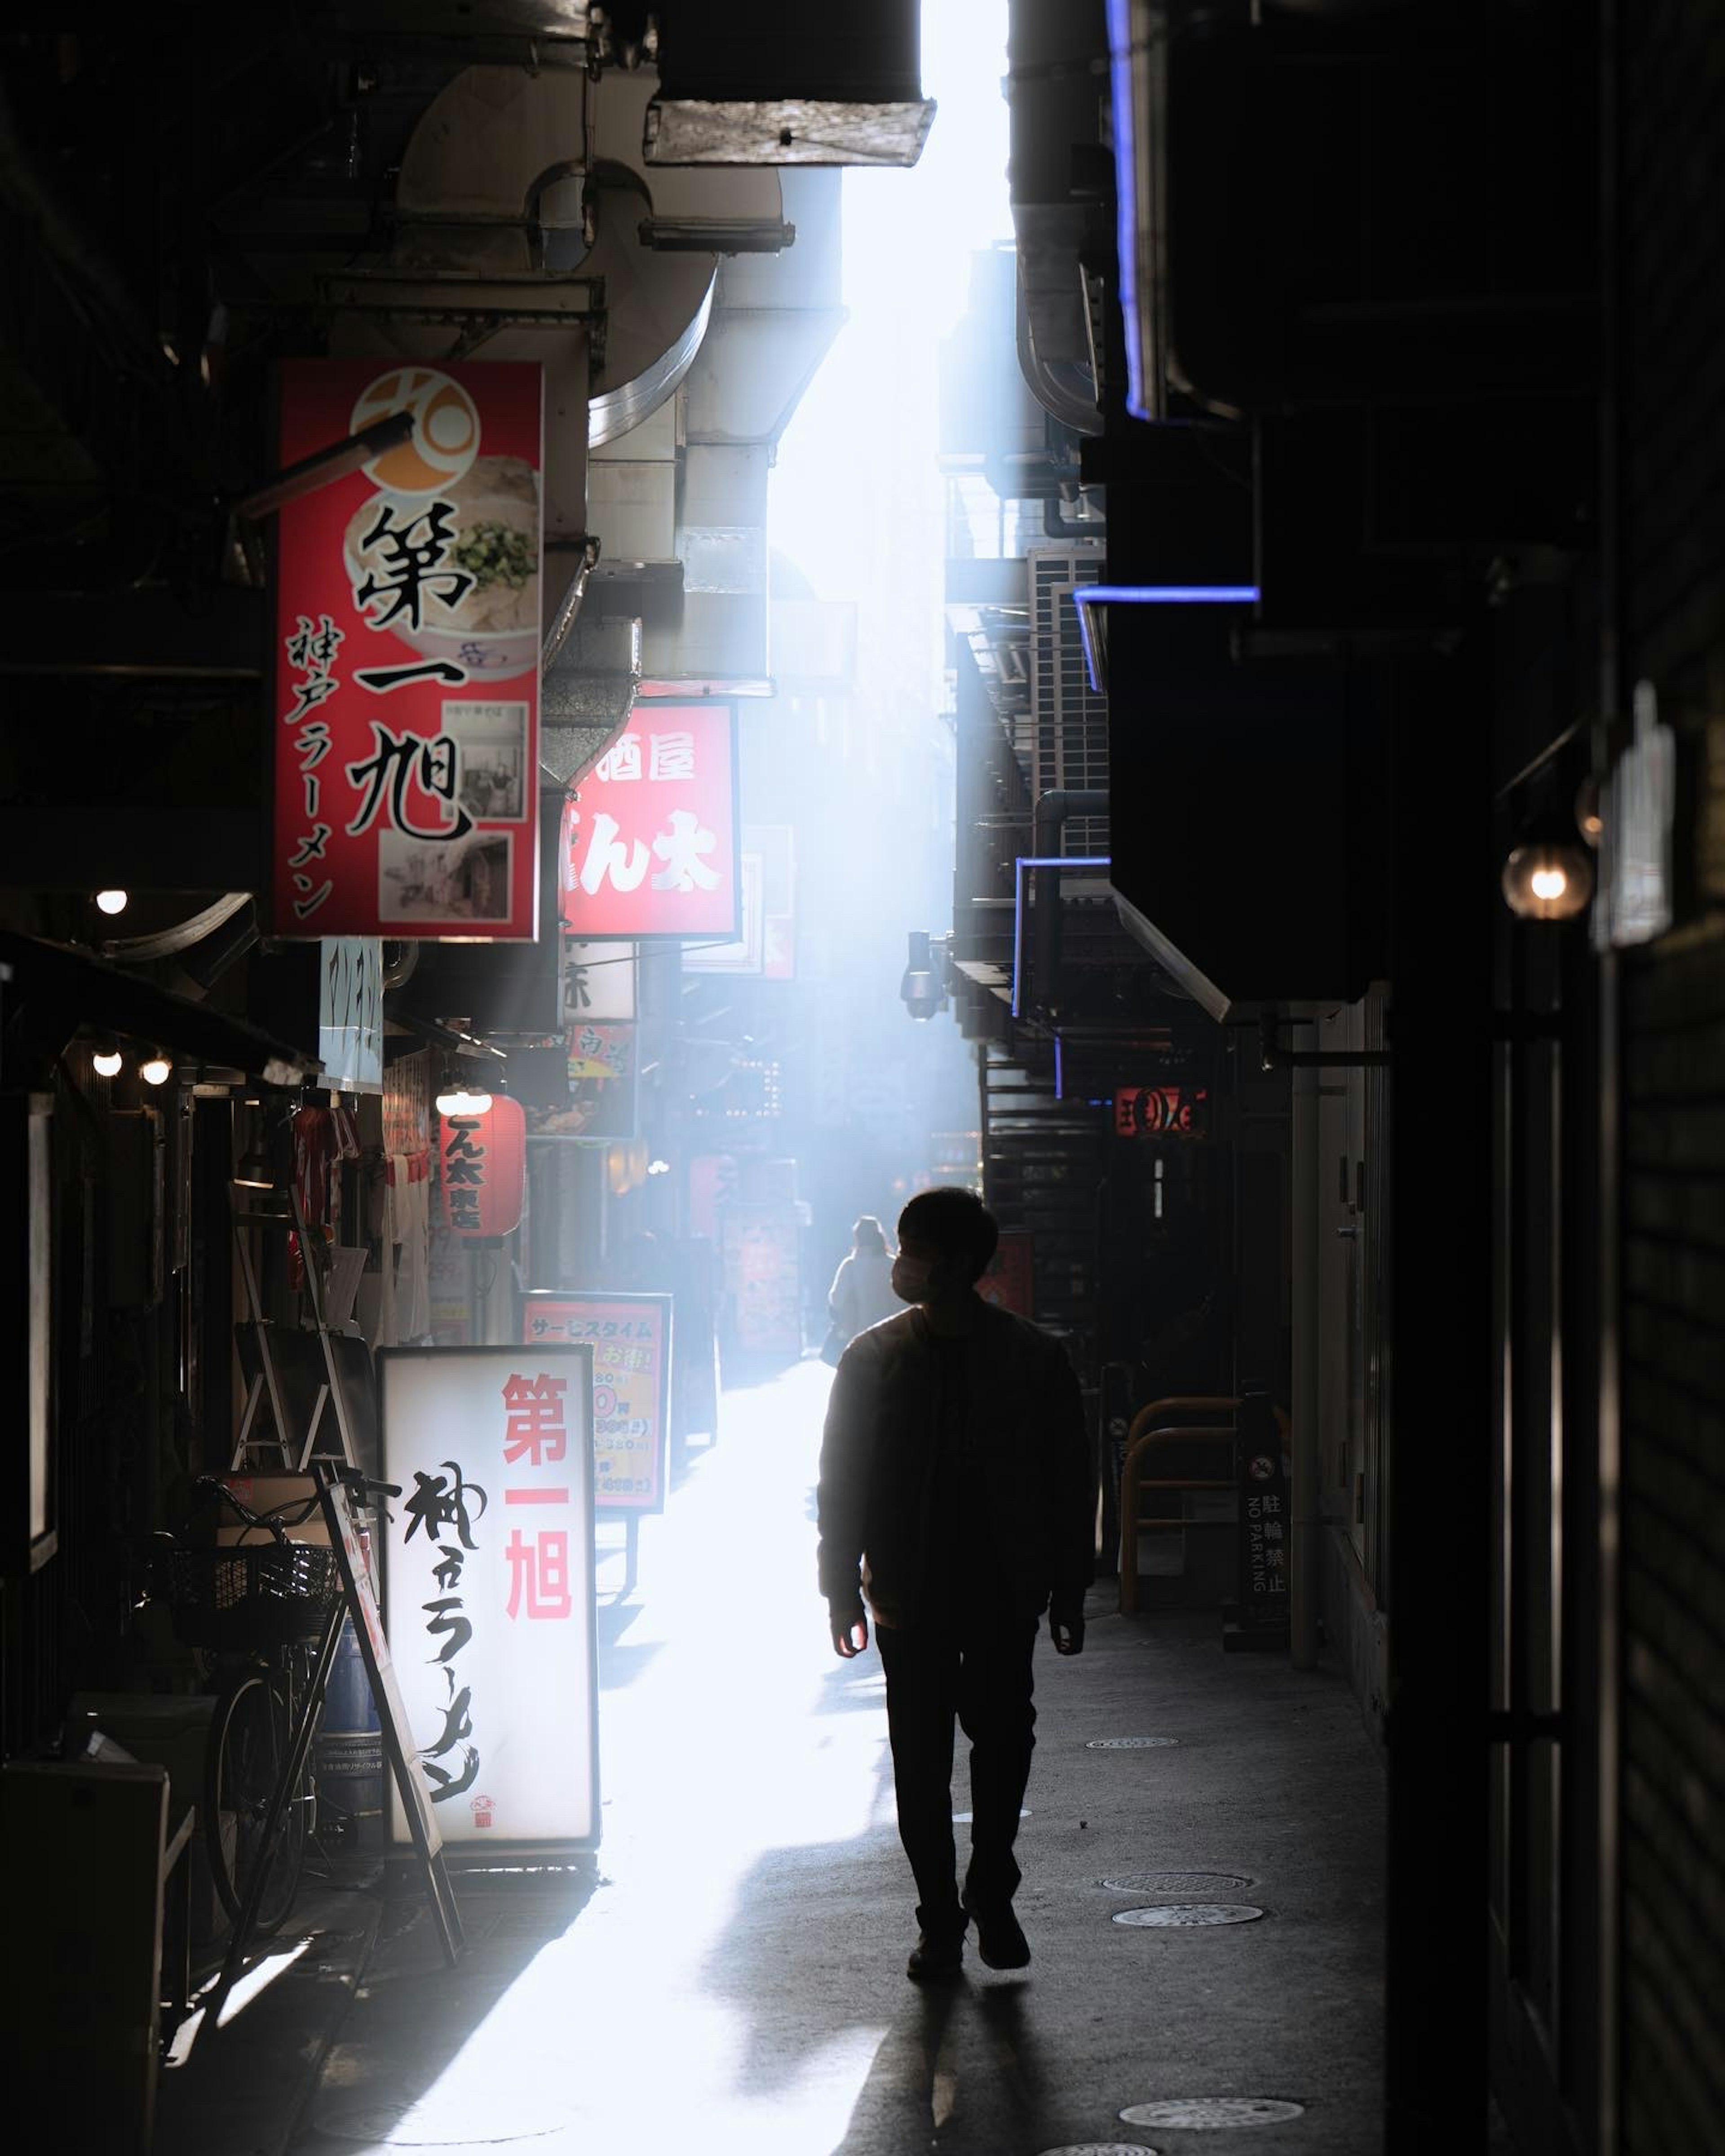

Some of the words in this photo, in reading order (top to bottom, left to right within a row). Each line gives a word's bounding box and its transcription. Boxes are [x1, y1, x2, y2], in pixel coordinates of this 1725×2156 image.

[349, 503, 477, 841] 第一旭
[286, 617, 345, 919] 神戸ラーメン
[565, 808, 723, 895] ん太
[502, 1372, 571, 1621] 第一旭
[1247, 1496, 1262, 1519] NO
[1248, 1524, 1266, 1592] PARKING
[1262, 1494, 1285, 1592] 駐輪禁止
[403, 1460, 488, 1803] 神戸ラーメン
